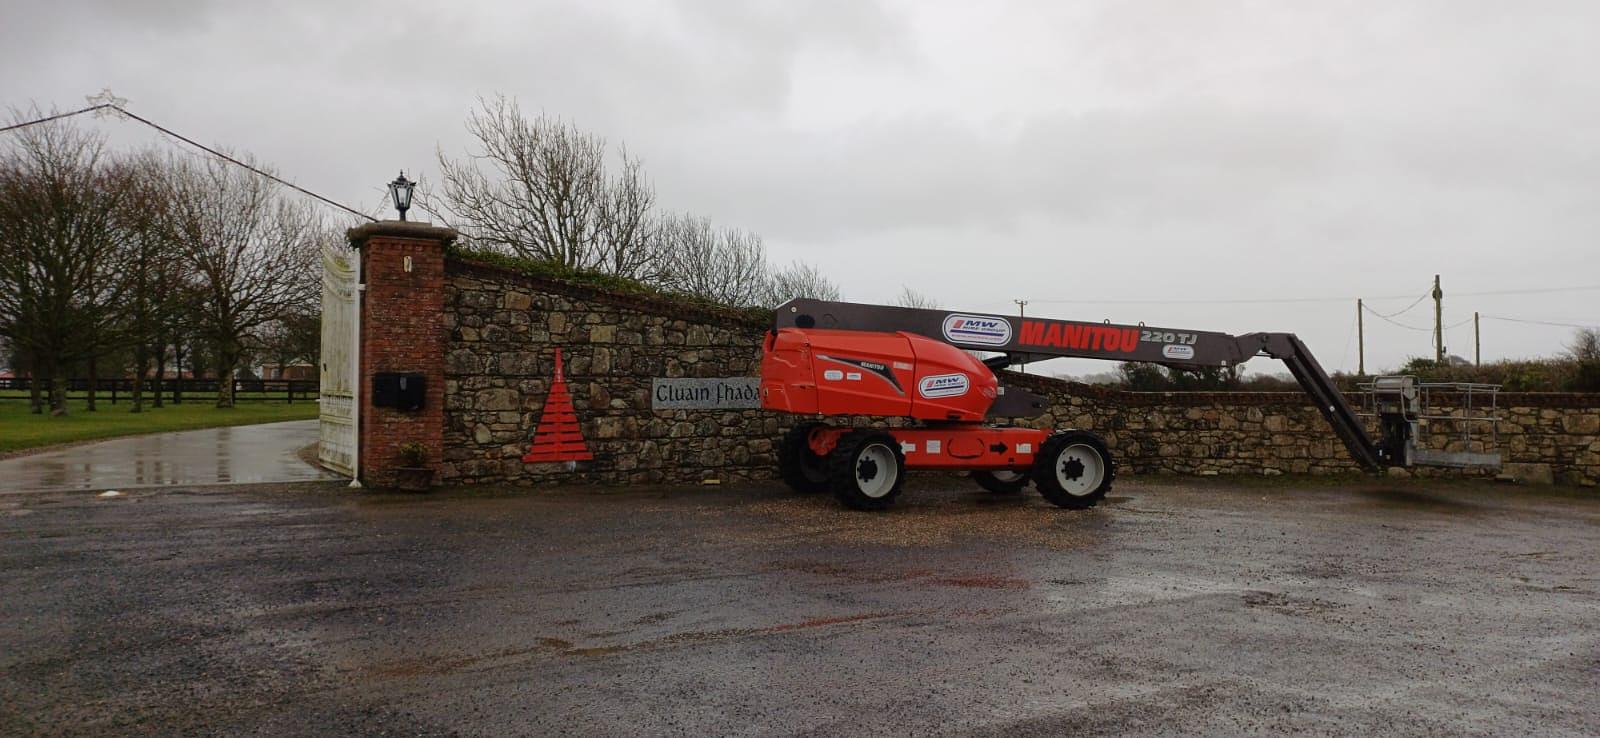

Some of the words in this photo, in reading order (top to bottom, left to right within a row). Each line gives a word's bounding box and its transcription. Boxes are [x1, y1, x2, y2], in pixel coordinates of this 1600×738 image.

[965, 320, 998, 328] MW
[1018, 321, 1139, 352] MANITOU
[1141, 330, 1175, 343] 220
[1178, 333, 1198, 345] TJ
[936, 377, 959, 385] MW
[656, 384, 710, 401] Cluain
